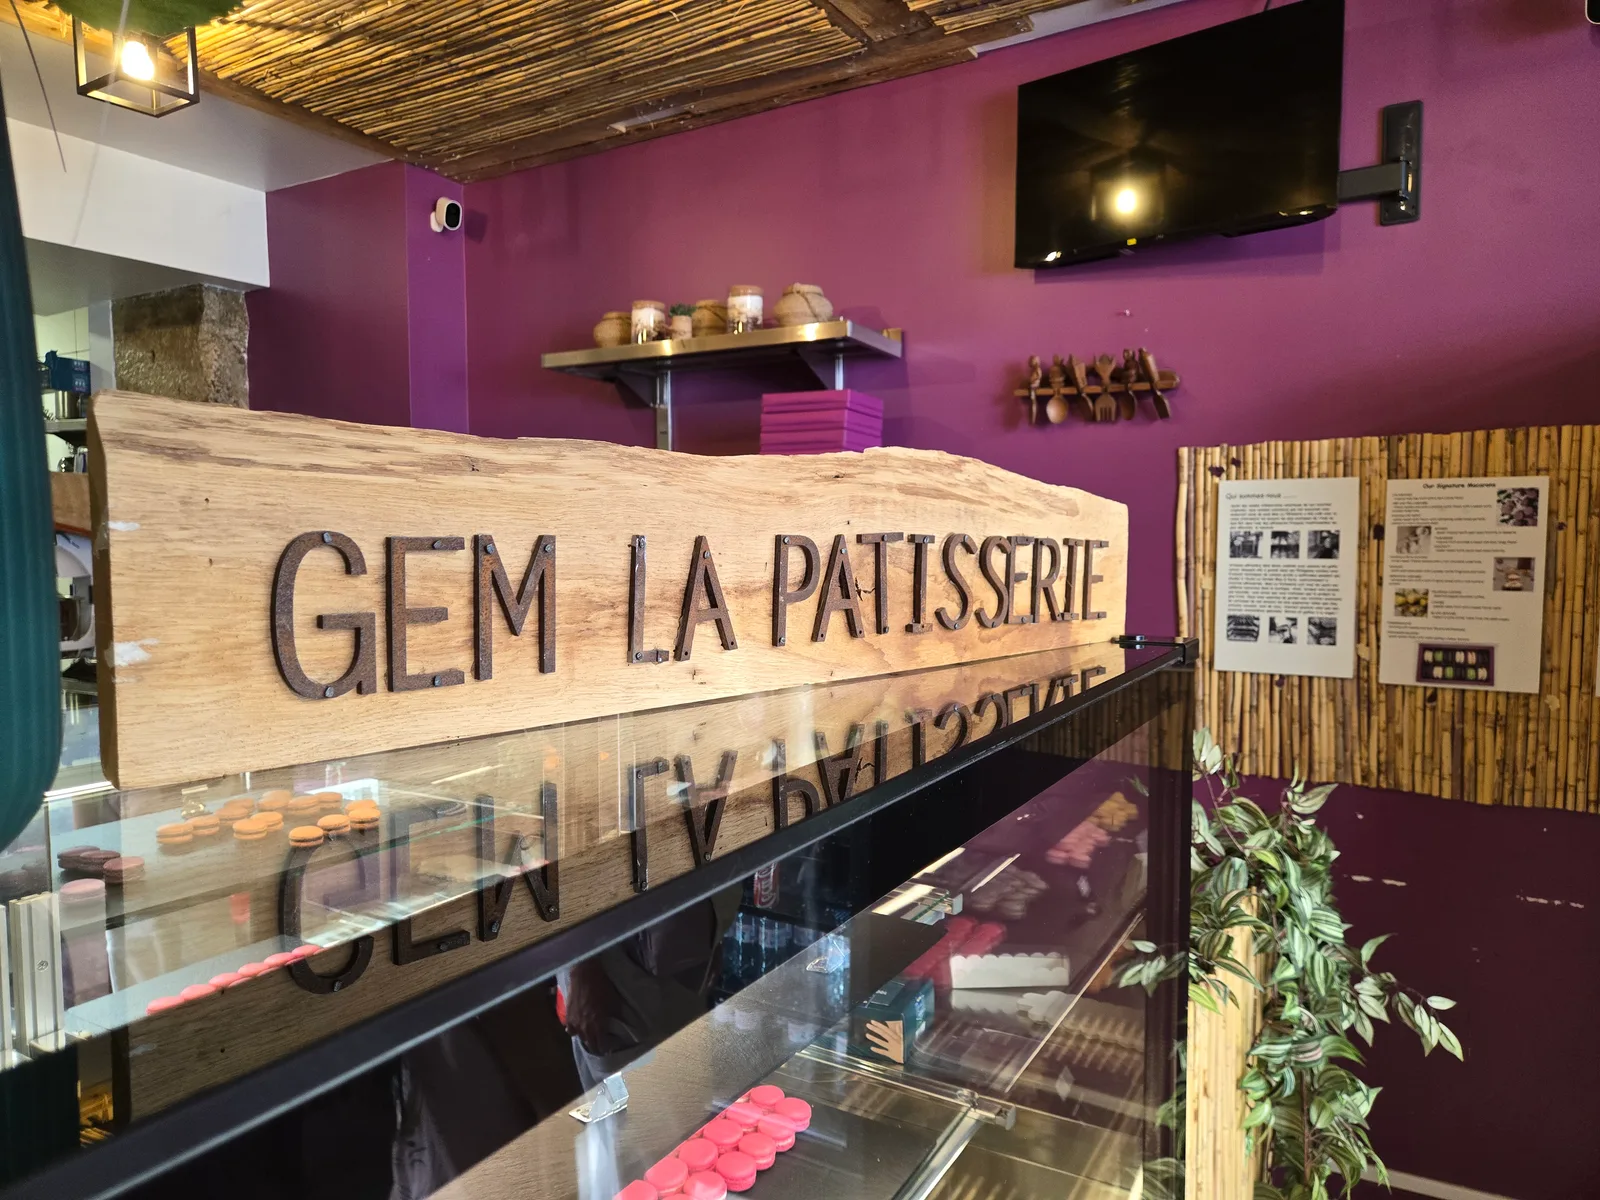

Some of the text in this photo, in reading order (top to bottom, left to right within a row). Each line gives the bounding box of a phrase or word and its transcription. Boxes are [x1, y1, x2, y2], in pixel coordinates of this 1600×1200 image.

[271, 530, 557, 700] GEM
[626, 534, 738, 663] LA
[771, 531, 1109, 648] PATISSERIE
